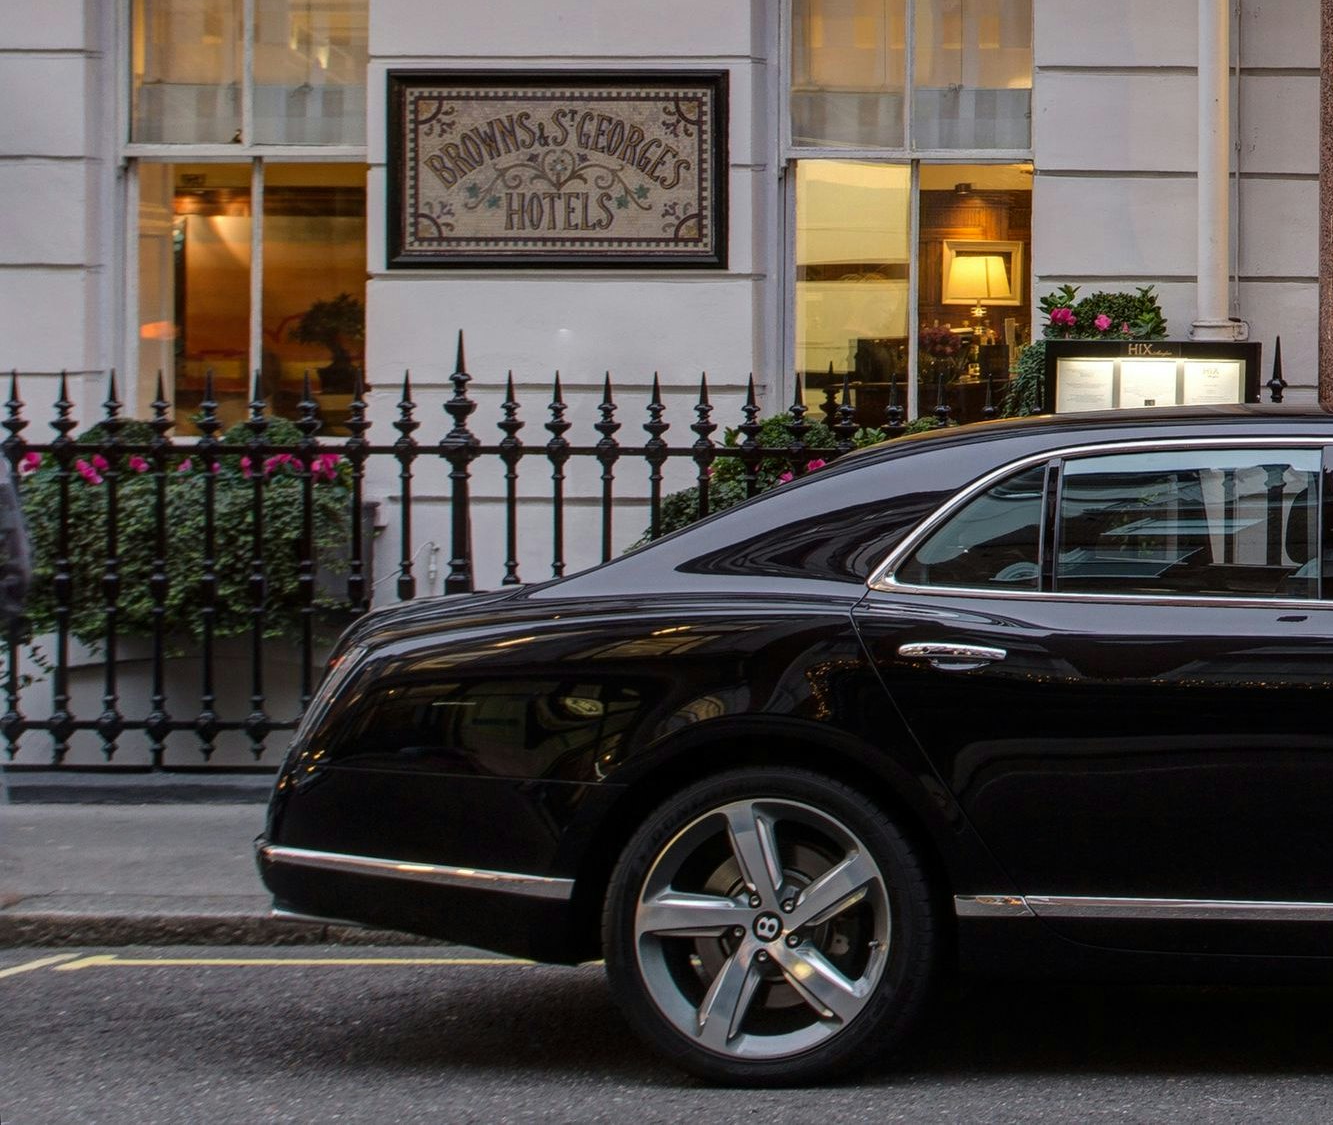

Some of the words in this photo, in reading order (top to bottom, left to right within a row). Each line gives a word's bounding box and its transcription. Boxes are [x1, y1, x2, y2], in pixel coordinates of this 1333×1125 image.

[424, 111, 536, 190] BROWNS
[537, 121, 550, 148] &
[576, 111, 691, 190] GEORGES
[504, 192, 616, 231] HOTELS
[1128, 343, 1153, 355] HIX
